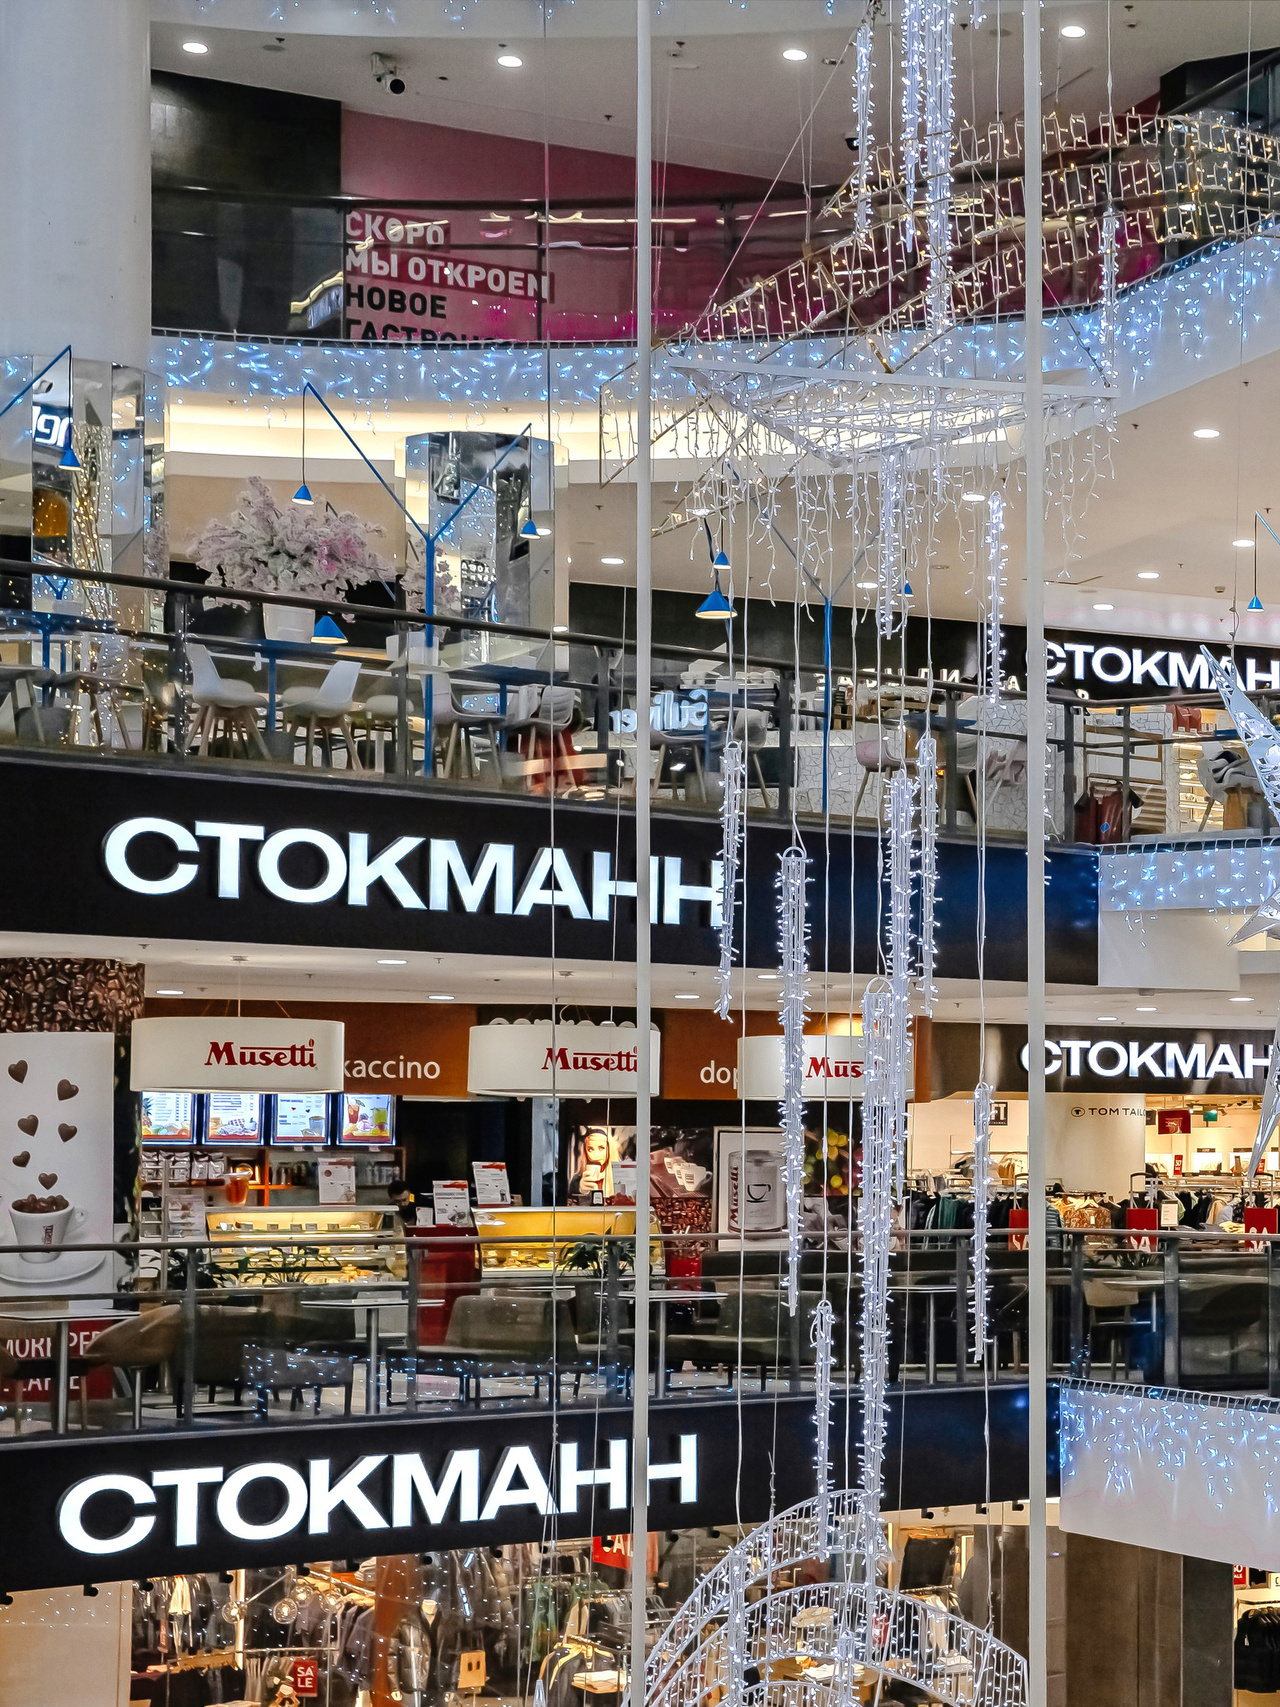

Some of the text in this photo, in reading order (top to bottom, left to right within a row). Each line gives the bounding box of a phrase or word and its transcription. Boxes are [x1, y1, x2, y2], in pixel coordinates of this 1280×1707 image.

[346, 211, 445, 244] СКОРО
[346, 248, 398, 277] МЫ
[346, 283, 447, 319] НОВОЕ
[104, 816, 724, 929] СТОКМАНН
[204, 1038, 318, 1068] Musetti
[58, 1433, 698, 1555] СТОКМАНН
